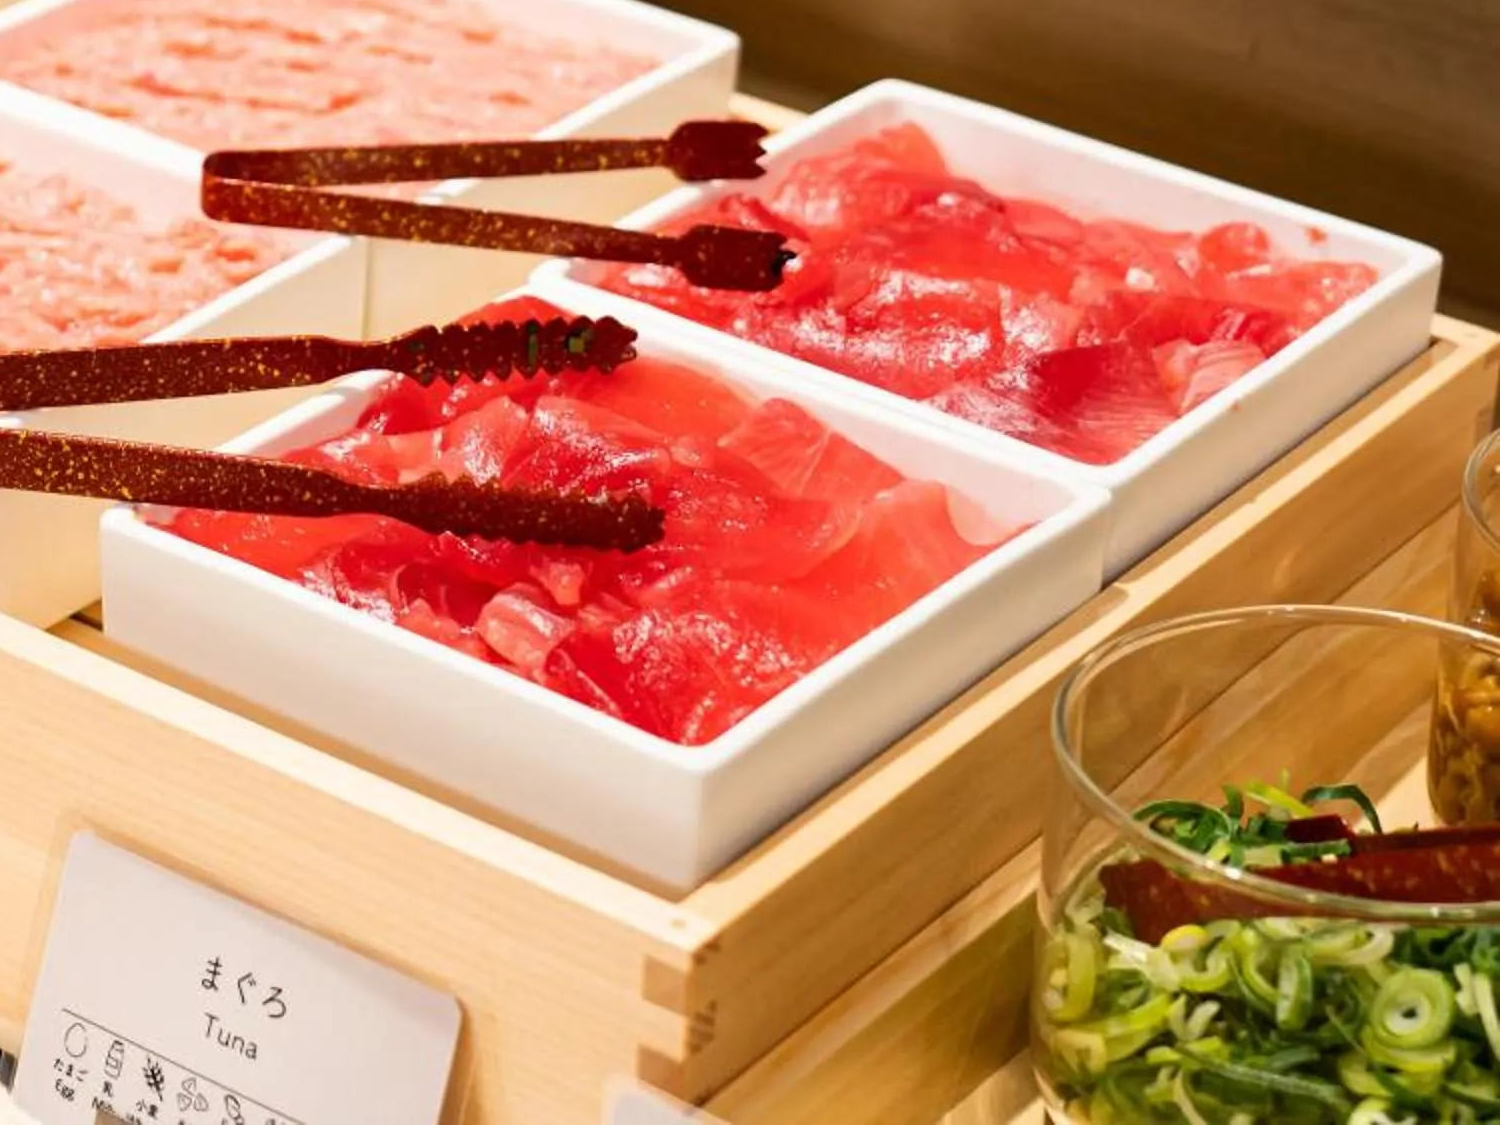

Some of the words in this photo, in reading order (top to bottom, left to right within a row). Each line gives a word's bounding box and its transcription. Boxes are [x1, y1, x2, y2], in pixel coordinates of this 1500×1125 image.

[201, 955, 287, 1019] まぐろ
[204, 1011, 258, 1061] Tuna
